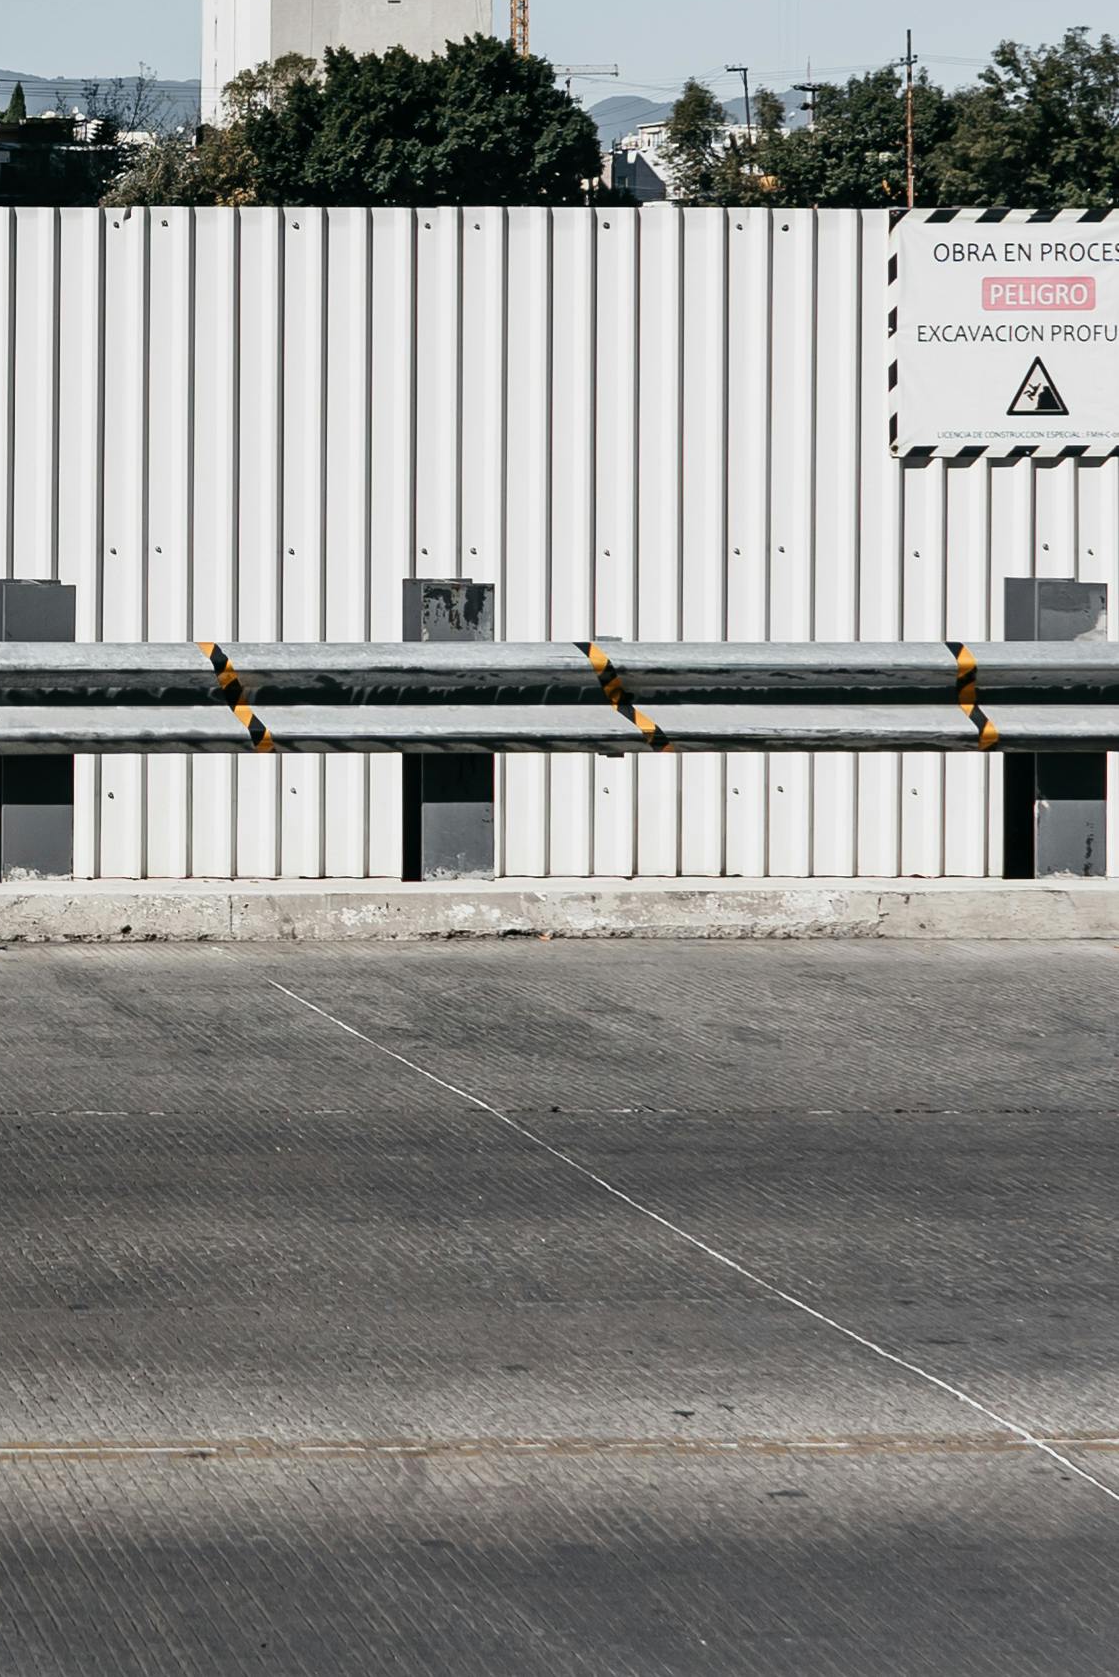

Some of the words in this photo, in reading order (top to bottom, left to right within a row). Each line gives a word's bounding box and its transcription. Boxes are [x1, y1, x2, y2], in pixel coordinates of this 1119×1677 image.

[933, 242, 998, 263] OBRA
[1004, 242, 1032, 263] EN
[989, 283, 1089, 306] PELIGRO
[917, 324, 1044, 343] EXCAVACION
[1050, 324, 1118, 343] PROFU
[937, 430, 971, 439] LICENCIA
[972, 430, 983, 439] DE
